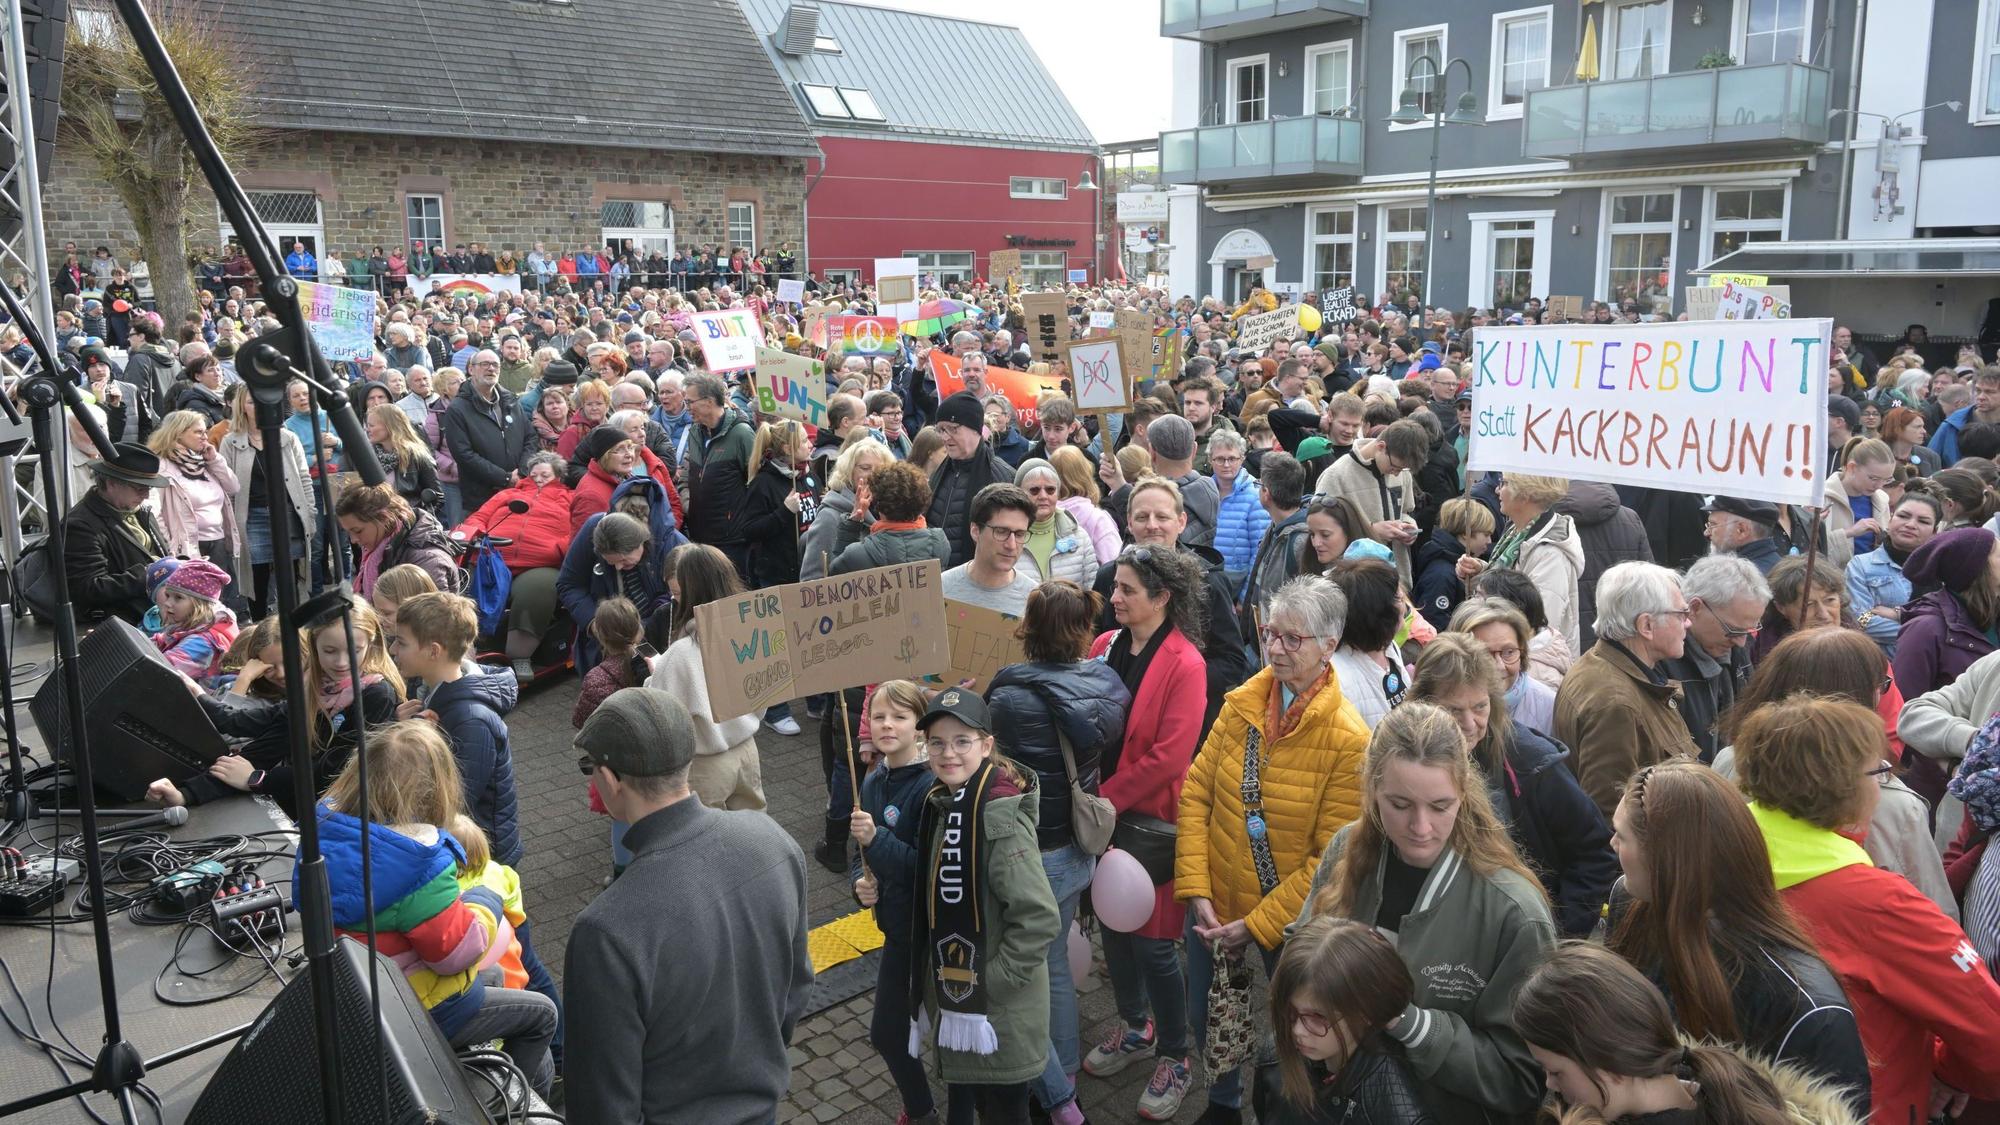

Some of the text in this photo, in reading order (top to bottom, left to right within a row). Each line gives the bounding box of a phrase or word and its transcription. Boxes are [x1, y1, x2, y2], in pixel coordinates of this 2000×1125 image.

[302, 301, 374, 323] olidarisch
[338, 288, 373, 302] lieber
[701, 315, 747, 339] BUNT
[1474, 337, 1822, 394] KUNTERBUNT
[757, 374, 827, 427] BUNT
[1477, 405, 1517, 438] statt
[738, 565, 928, 624] FÜR DEMOKRATIE
[730, 592, 901, 665] WIR WOLLEN
